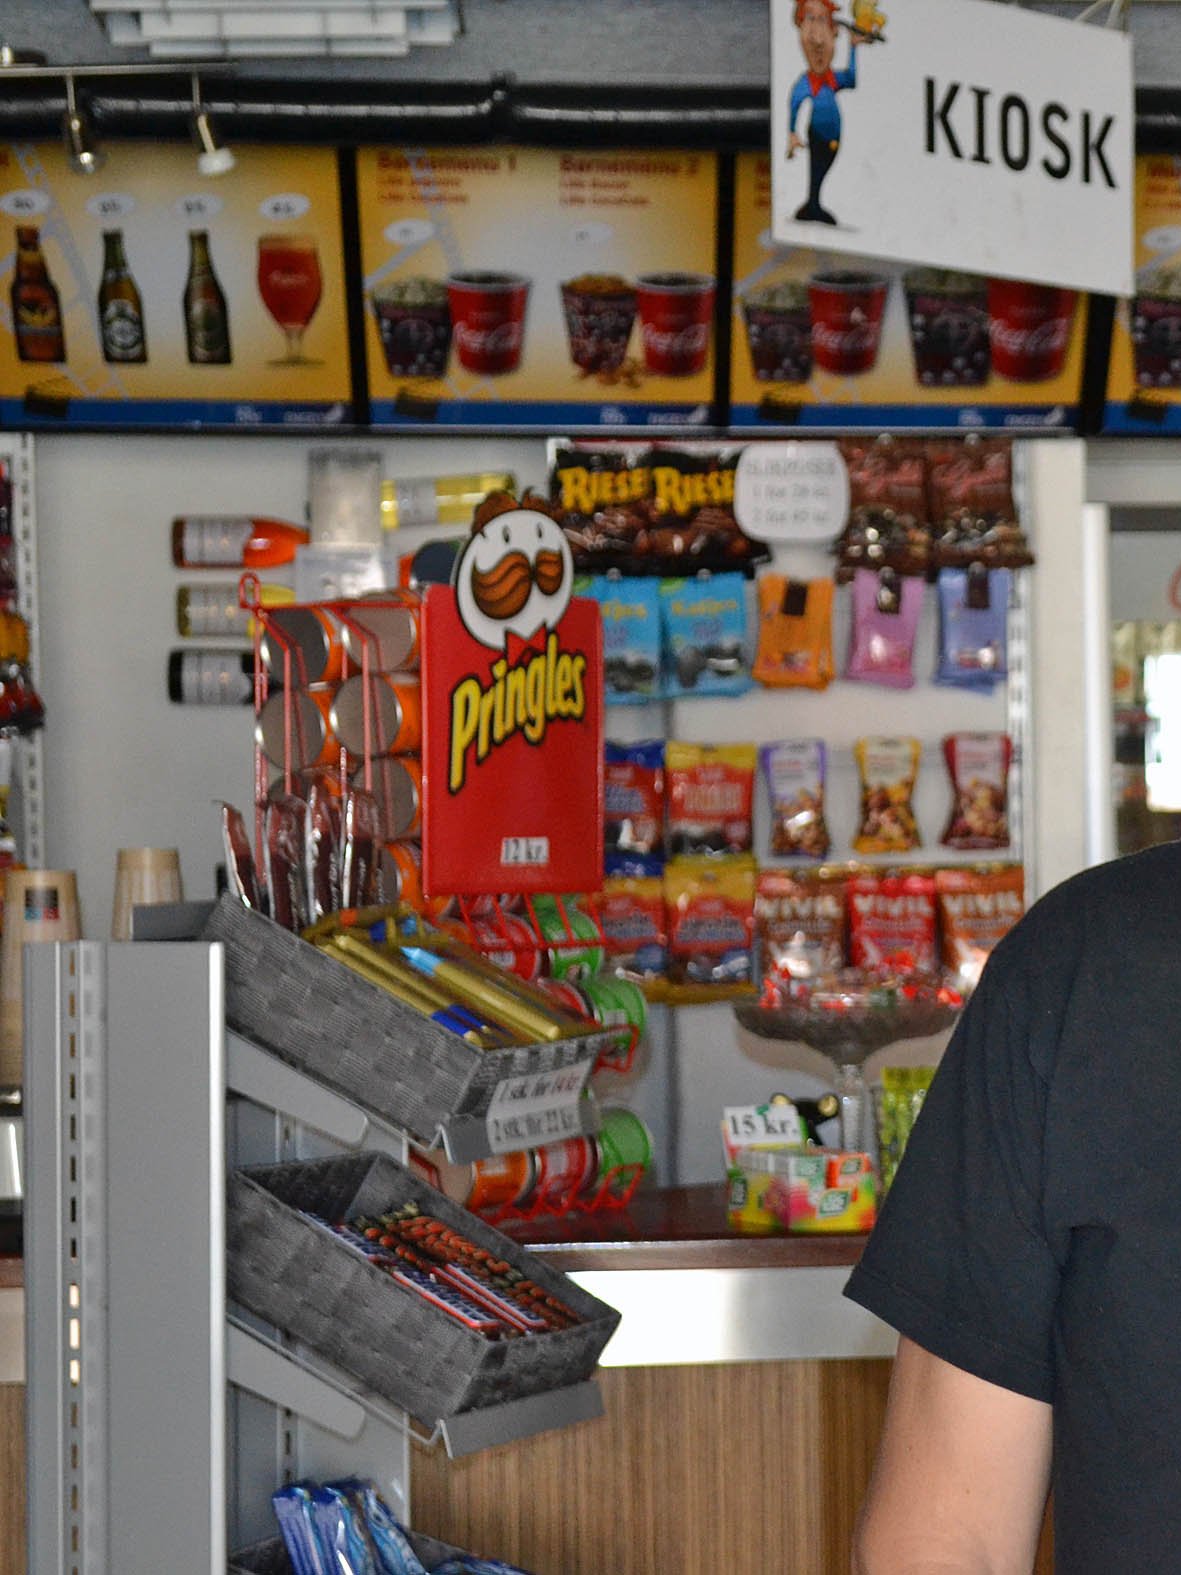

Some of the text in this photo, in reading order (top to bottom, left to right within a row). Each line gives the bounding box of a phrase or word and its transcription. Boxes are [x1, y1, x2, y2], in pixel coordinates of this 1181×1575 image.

[923, 76, 1118, 190] KIOSK
[448, 631, 587, 796] Pringles
[502, 838, 521, 862] 12
[730, 1111, 798, 1136] 15 kr.
